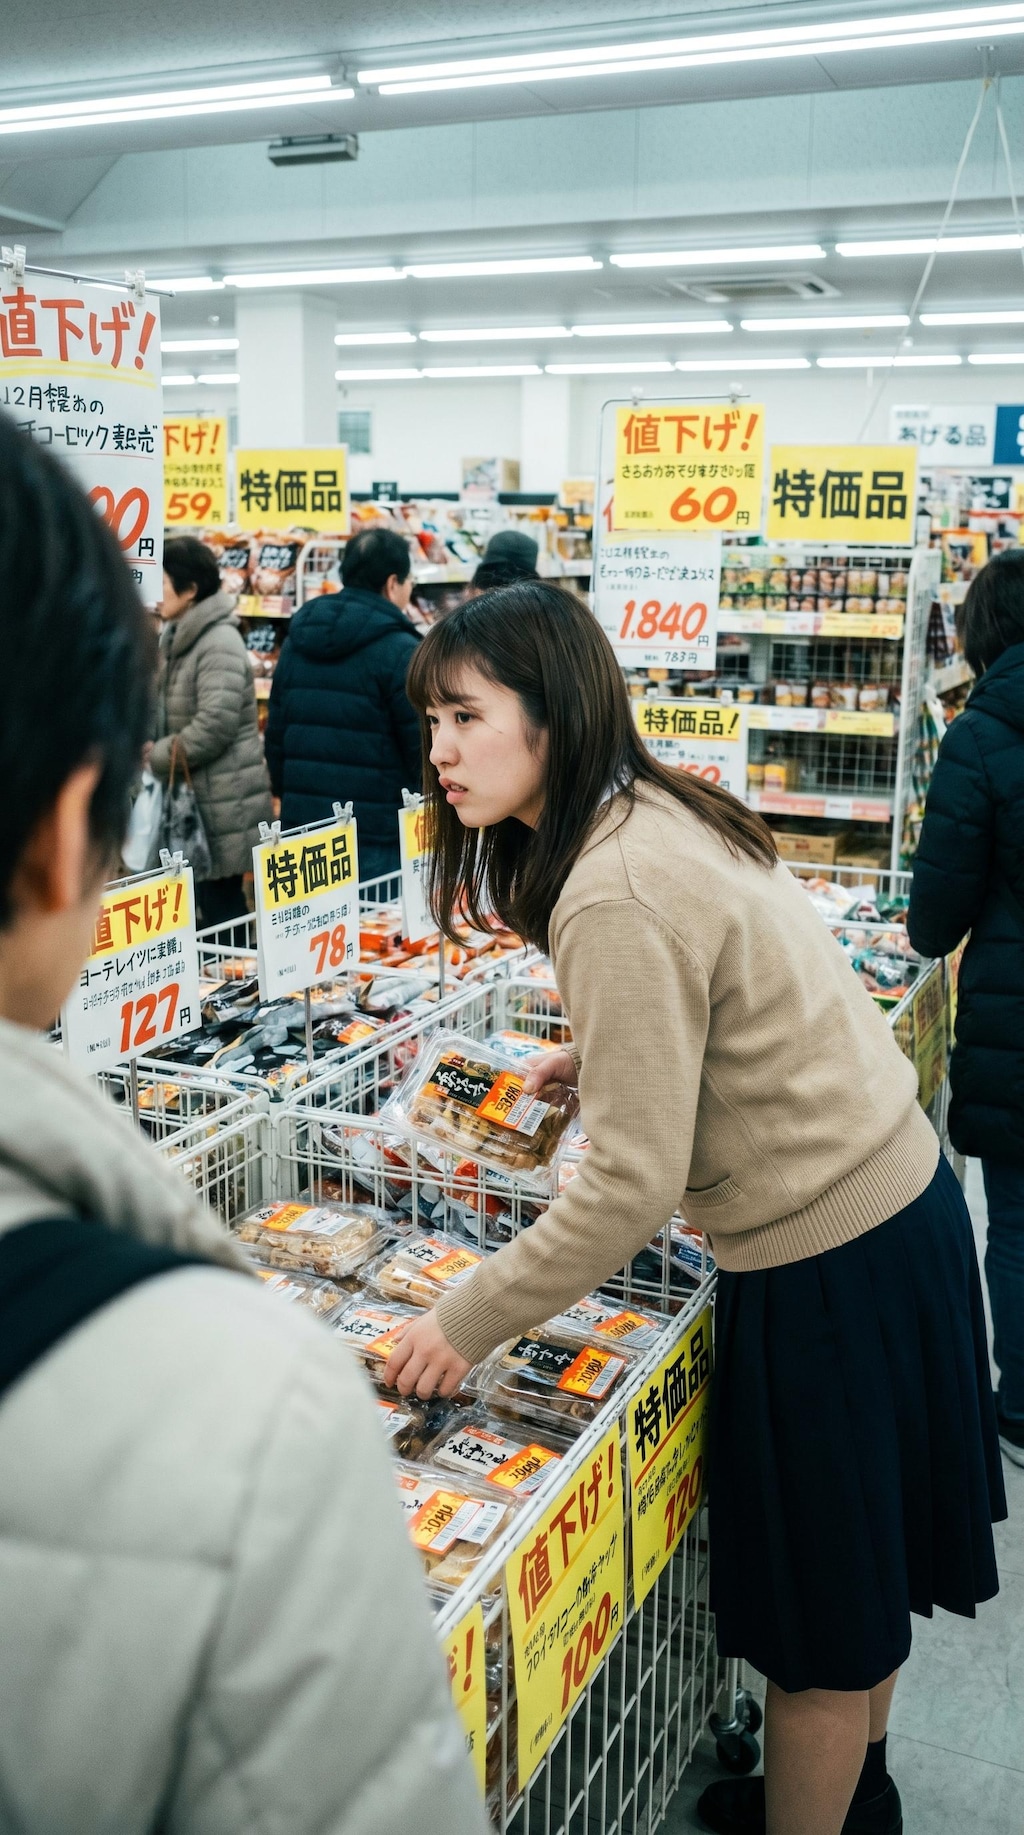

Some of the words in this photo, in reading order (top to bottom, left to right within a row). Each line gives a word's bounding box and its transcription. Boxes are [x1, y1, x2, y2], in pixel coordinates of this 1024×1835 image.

[623, 410, 759, 455] 値下げ!
[239, 469, 342, 512] 特価品
[773, 468, 908, 520] 特価品
[644, 708, 740, 735] 特価品!
[266, 834, 352, 902] 特価品
[633, 1326, 711, 1463] 特価品
[518, 1442, 614, 1625] 値下げ!
